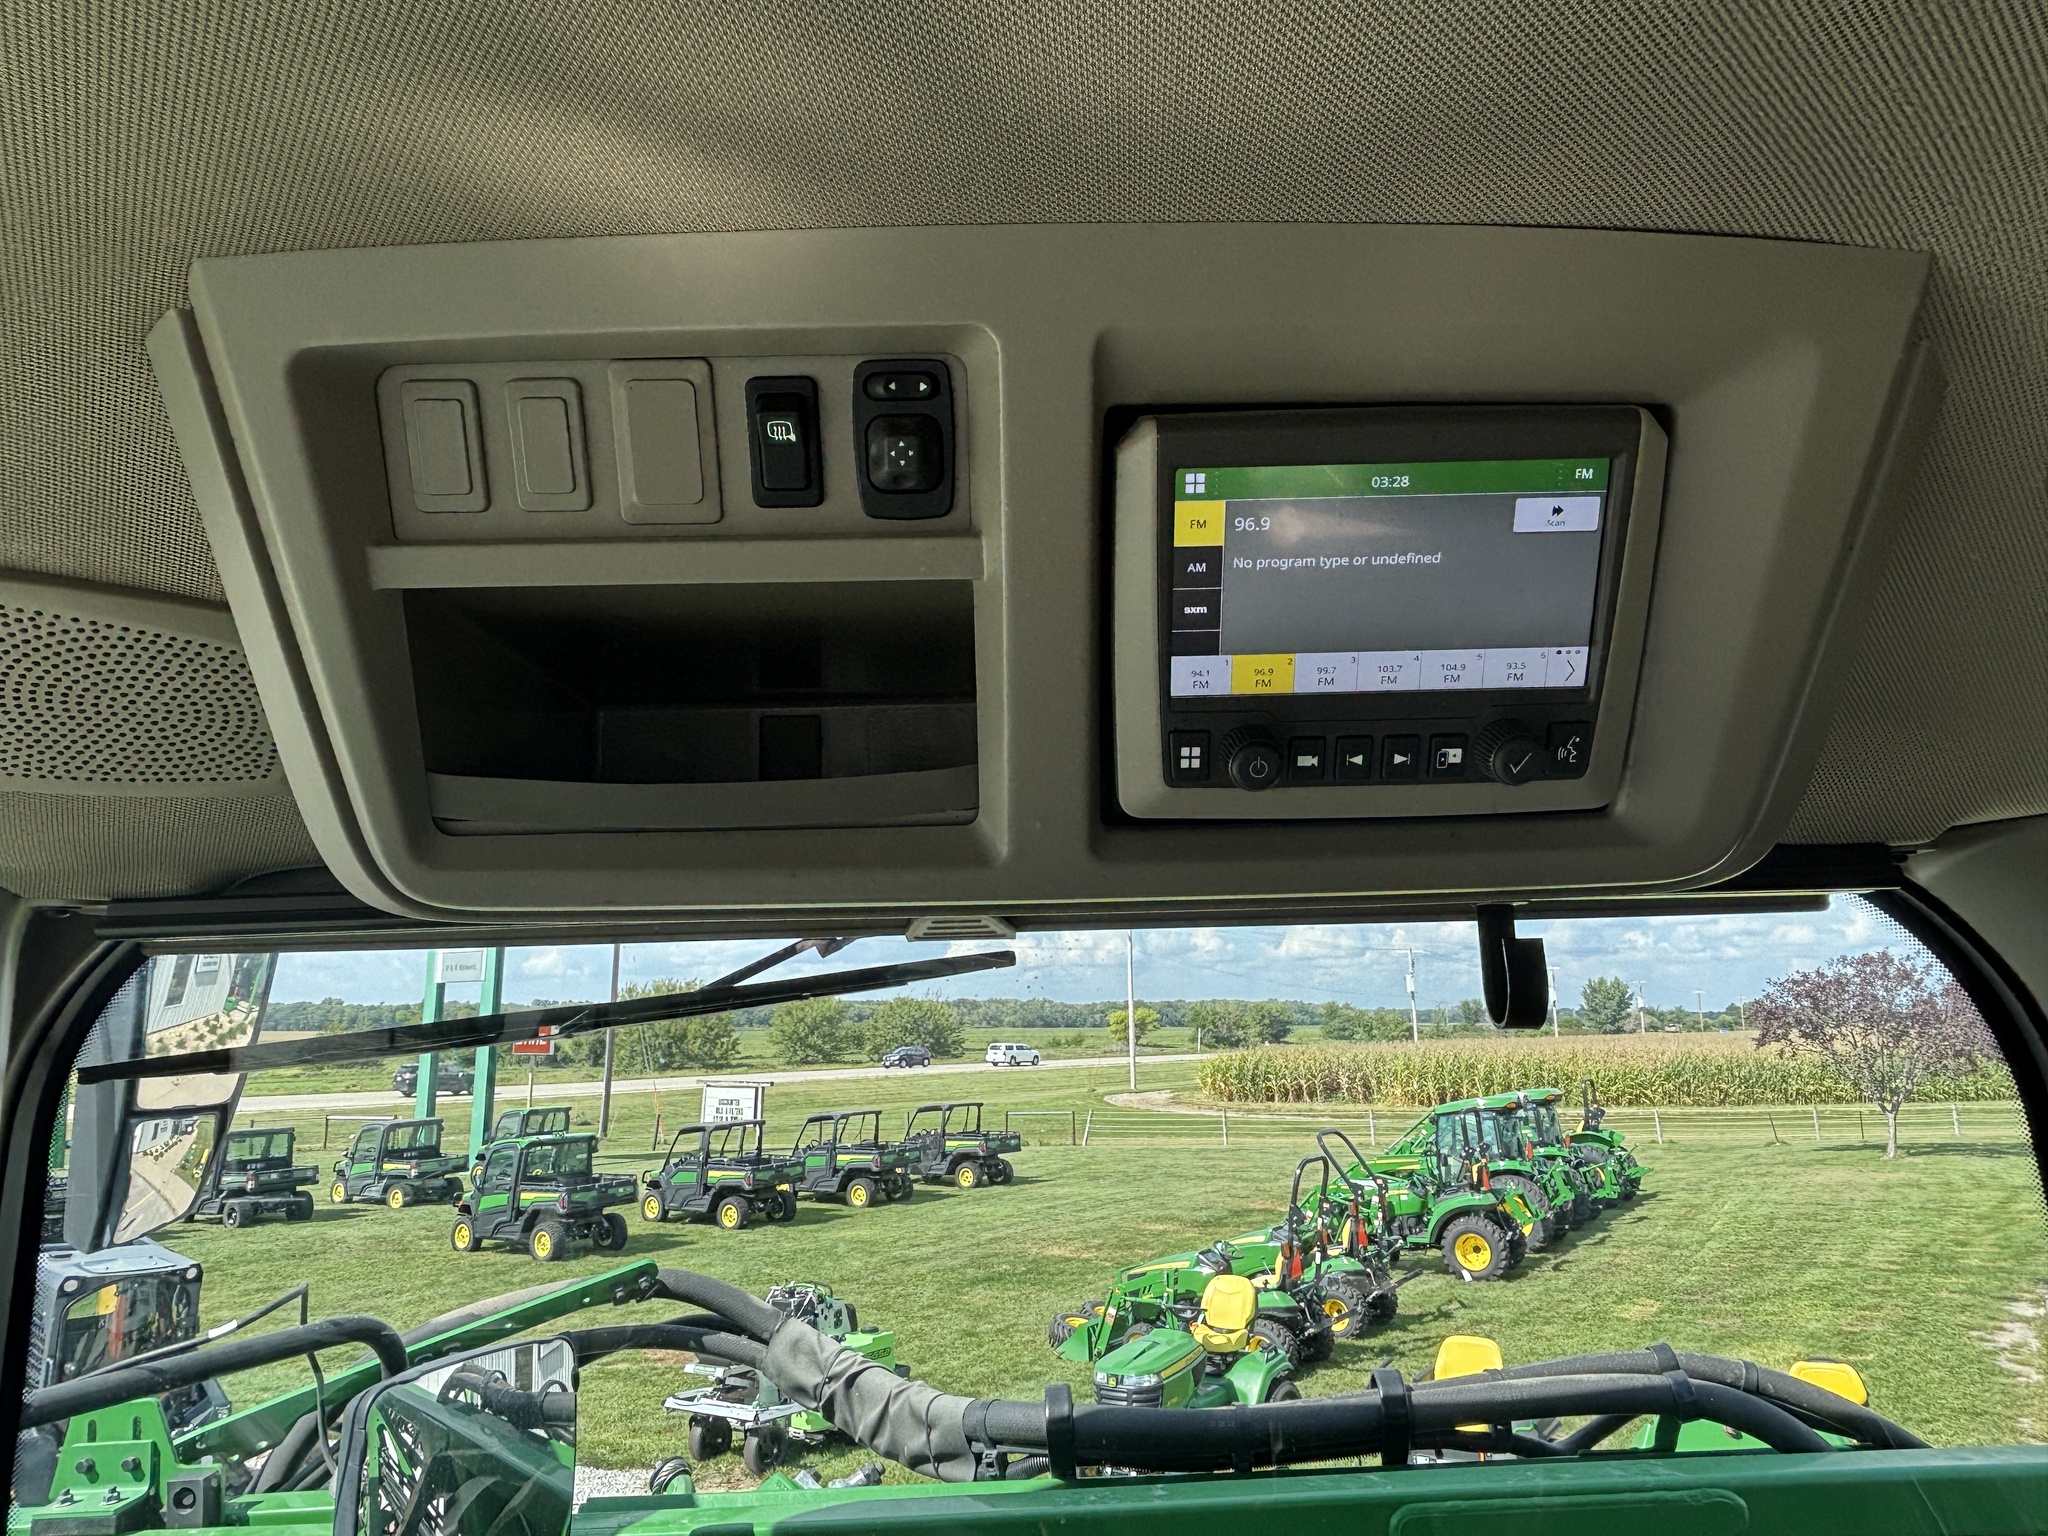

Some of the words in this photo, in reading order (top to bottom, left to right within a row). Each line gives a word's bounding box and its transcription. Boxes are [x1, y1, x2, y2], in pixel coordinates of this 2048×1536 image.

[1575, 468, 1594, 480] FM
[1371, 475, 1410, 488] 03:28
[1190, 519, 1207, 529] FM
[1234, 517, 1270, 531] 96.9
[1546, 519, 1566, 527] Scan
[1233, 557, 1253, 569] No
[1256, 557, 1316, 571] program
[1319, 556, 1350, 569] type
[1353, 556, 1368, 566] or
[1371, 552, 1442, 565] undefined
[1187, 563, 1206, 572] AM
[1184, 606, 1208, 614] sxm
[1287, 658, 1293, 666] 2
[1350, 656, 1356, 664] 3
[1317, 666, 1337, 674] 99.7
[1378, 665, 1403, 673] 103.7
[1440, 663, 1466, 671] 104.9
[1506, 661, 1526, 670] 93.5
[1191, 670, 1210, 678] 94.1
[1254, 668, 1274, 676] 96.9
[1506, 672, 1524, 681] FM
[1317, 677, 1335, 686] FM
[1380, 676, 1397, 685] FM
[1443, 674, 1460, 683] FM
[1192, 681, 1210, 689] FM
[1255, 679, 1272, 688] FM
